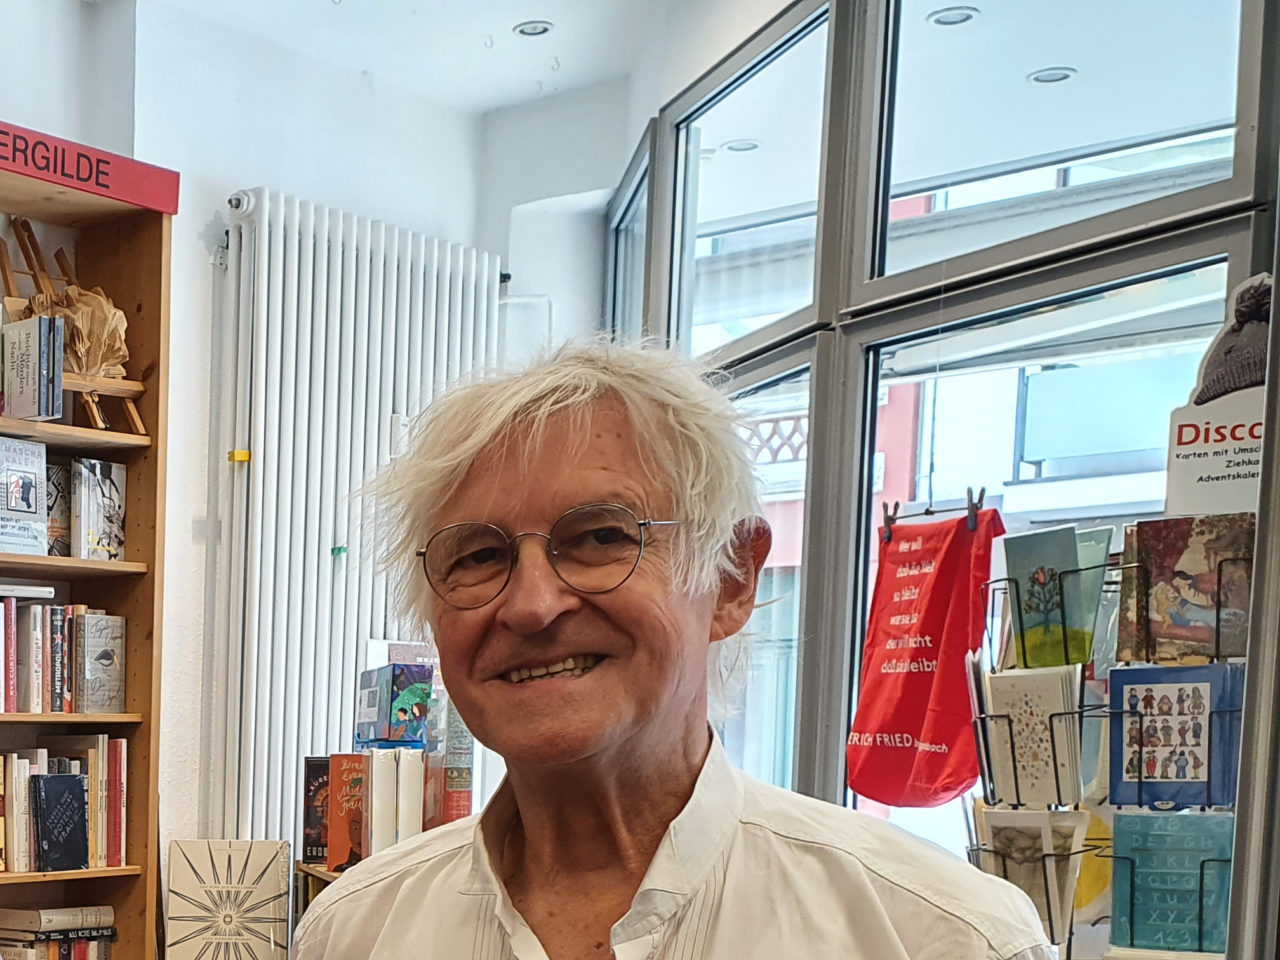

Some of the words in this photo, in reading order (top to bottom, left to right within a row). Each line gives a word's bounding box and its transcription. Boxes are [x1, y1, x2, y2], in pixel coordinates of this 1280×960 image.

[1176, 450, 1208, 460] Karten
[1213, 448, 1229, 457] mit
[1233, 444, 1261, 455] Umsc
[876, 732, 912, 748] FRIED
[308, 776, 328, 796] LAURE
[1154, 928, 1192, 946] 123
